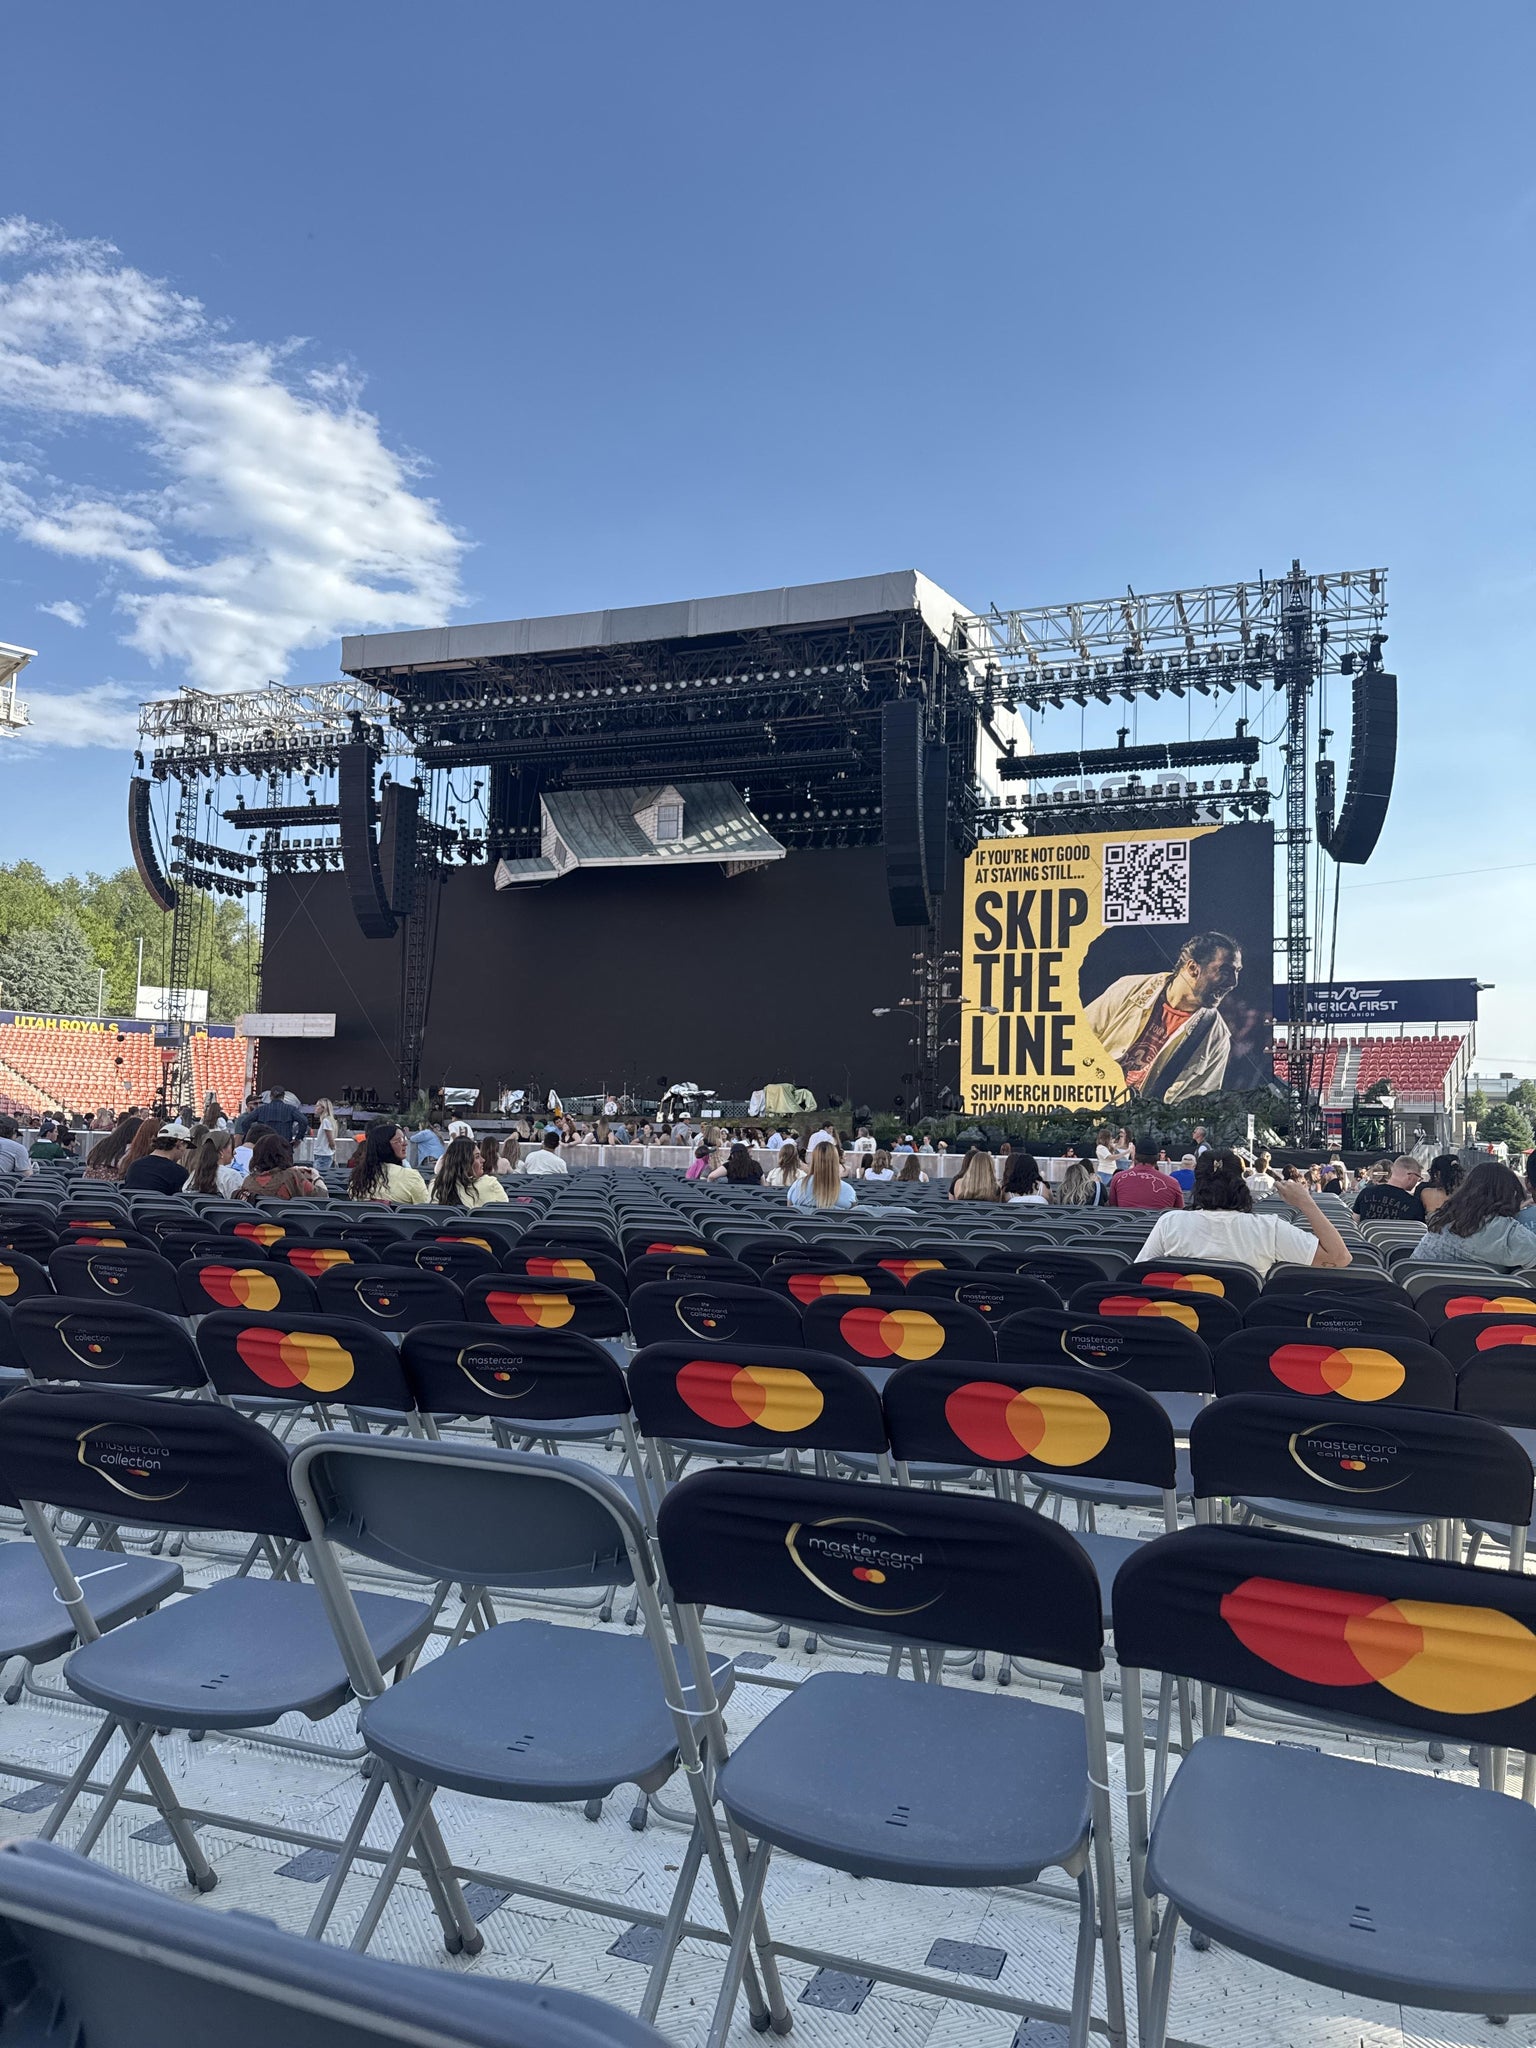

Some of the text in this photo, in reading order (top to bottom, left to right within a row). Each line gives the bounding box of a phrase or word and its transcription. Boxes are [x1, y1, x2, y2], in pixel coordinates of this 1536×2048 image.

[975, 845, 1090, 866] IF YOU'RE NOT GOOD
[975, 864, 1085, 884] AT STAYING STILL...
[974, 888, 1088, 951] SKIP
[973, 952, 1063, 1012] THE
[1304, 1001, 1398, 1012] MERICA FIRST
[14, 1016, 119, 1033] UTAH ROYALS
[971, 1015, 1076, 1075] LINE
[970, 1084, 1118, 1104] SHIP MERCH DIRECTLY
[970, 1103, 986, 1116] TO
[1028, 1104, 1064, 1115] DOO
[1369, 1203, 1399, 1217] NOAH
[690, 1311, 726, 1319] collection
[74, 1333, 111, 1342] collection
[1071, 1336, 1124, 1344] mastercard
[1076, 1343, 1120, 1352] collection
[468, 1357, 523, 1365] mastercard
[1307, 1440, 1397, 1455] mastercard
[100, 1452, 161, 1470] collection
[1316, 1451, 1389, 1464] collection
[856, 1532, 877, 1544] the
[808, 1538, 923, 1565] mastercard
